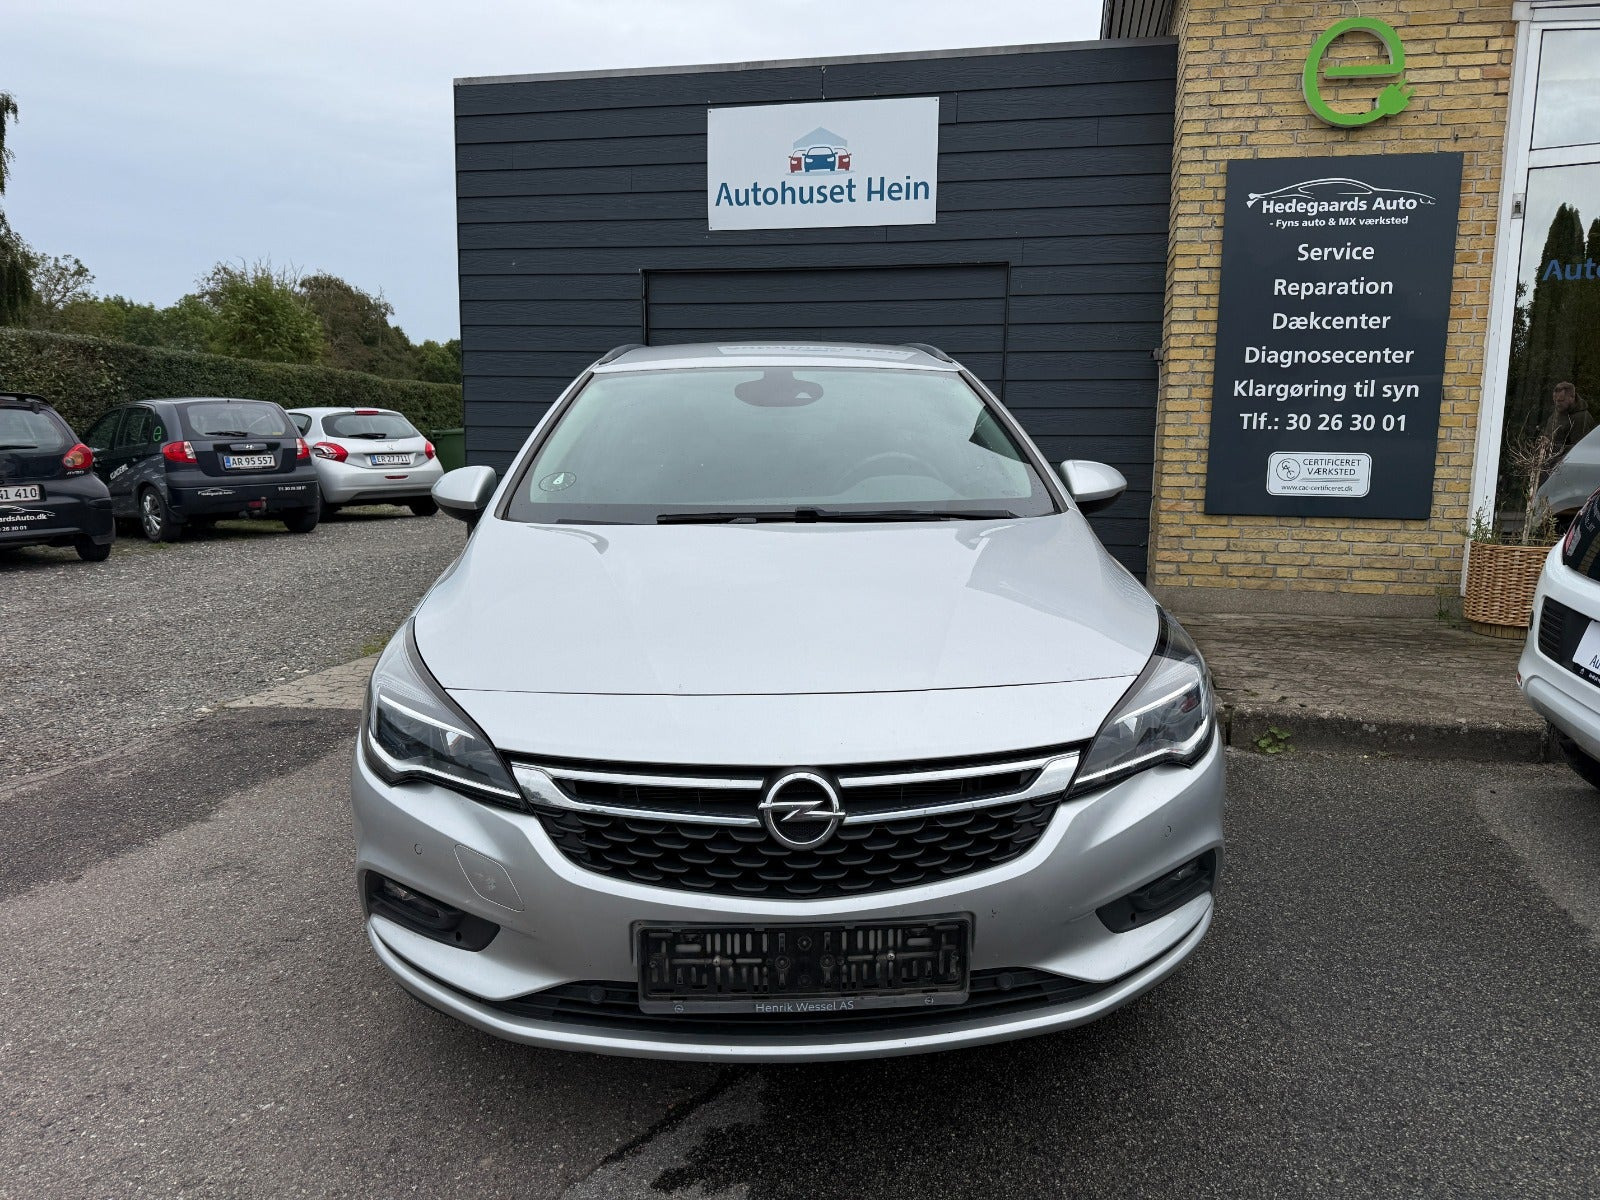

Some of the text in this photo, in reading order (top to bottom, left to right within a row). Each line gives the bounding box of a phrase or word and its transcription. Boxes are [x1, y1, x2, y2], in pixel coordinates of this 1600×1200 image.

[715, 175, 930, 207] Autohuset Hein
[1262, 196, 1418, 216] Hedegaards Auto
[1275, 218, 1299, 229] Fyns
[1301, 218, 1326, 227] auto
[1328, 217, 1336, 226] &
[1338, 217, 1357, 226] MX
[1358, 215, 1409, 226] værksted
[1297, 242, 1375, 261] Service
[1542, 258, 1600, 281] Aut
[1273, 276, 1394, 300] Reparation
[1272, 311, 1391, 330] Dækcenter
[1244, 346, 1415, 368] Diagnosecenter
[1233, 379, 1420, 402] Klargøring til syn
[1239, 412, 1407, 432] Tlf.: 30 26 30 01
[232, 456, 273, 466] AR 95 557
[376, 455, 386, 463] ER
[387, 455, 395, 463] 27
[1302, 458, 1362, 466] CERTIFICERET
[1307, 468, 1356, 476] VÆRKSTED
[15, 487, 37, 499] 410
[755, 1000, 854, 1013] Henrik Wessel AS
